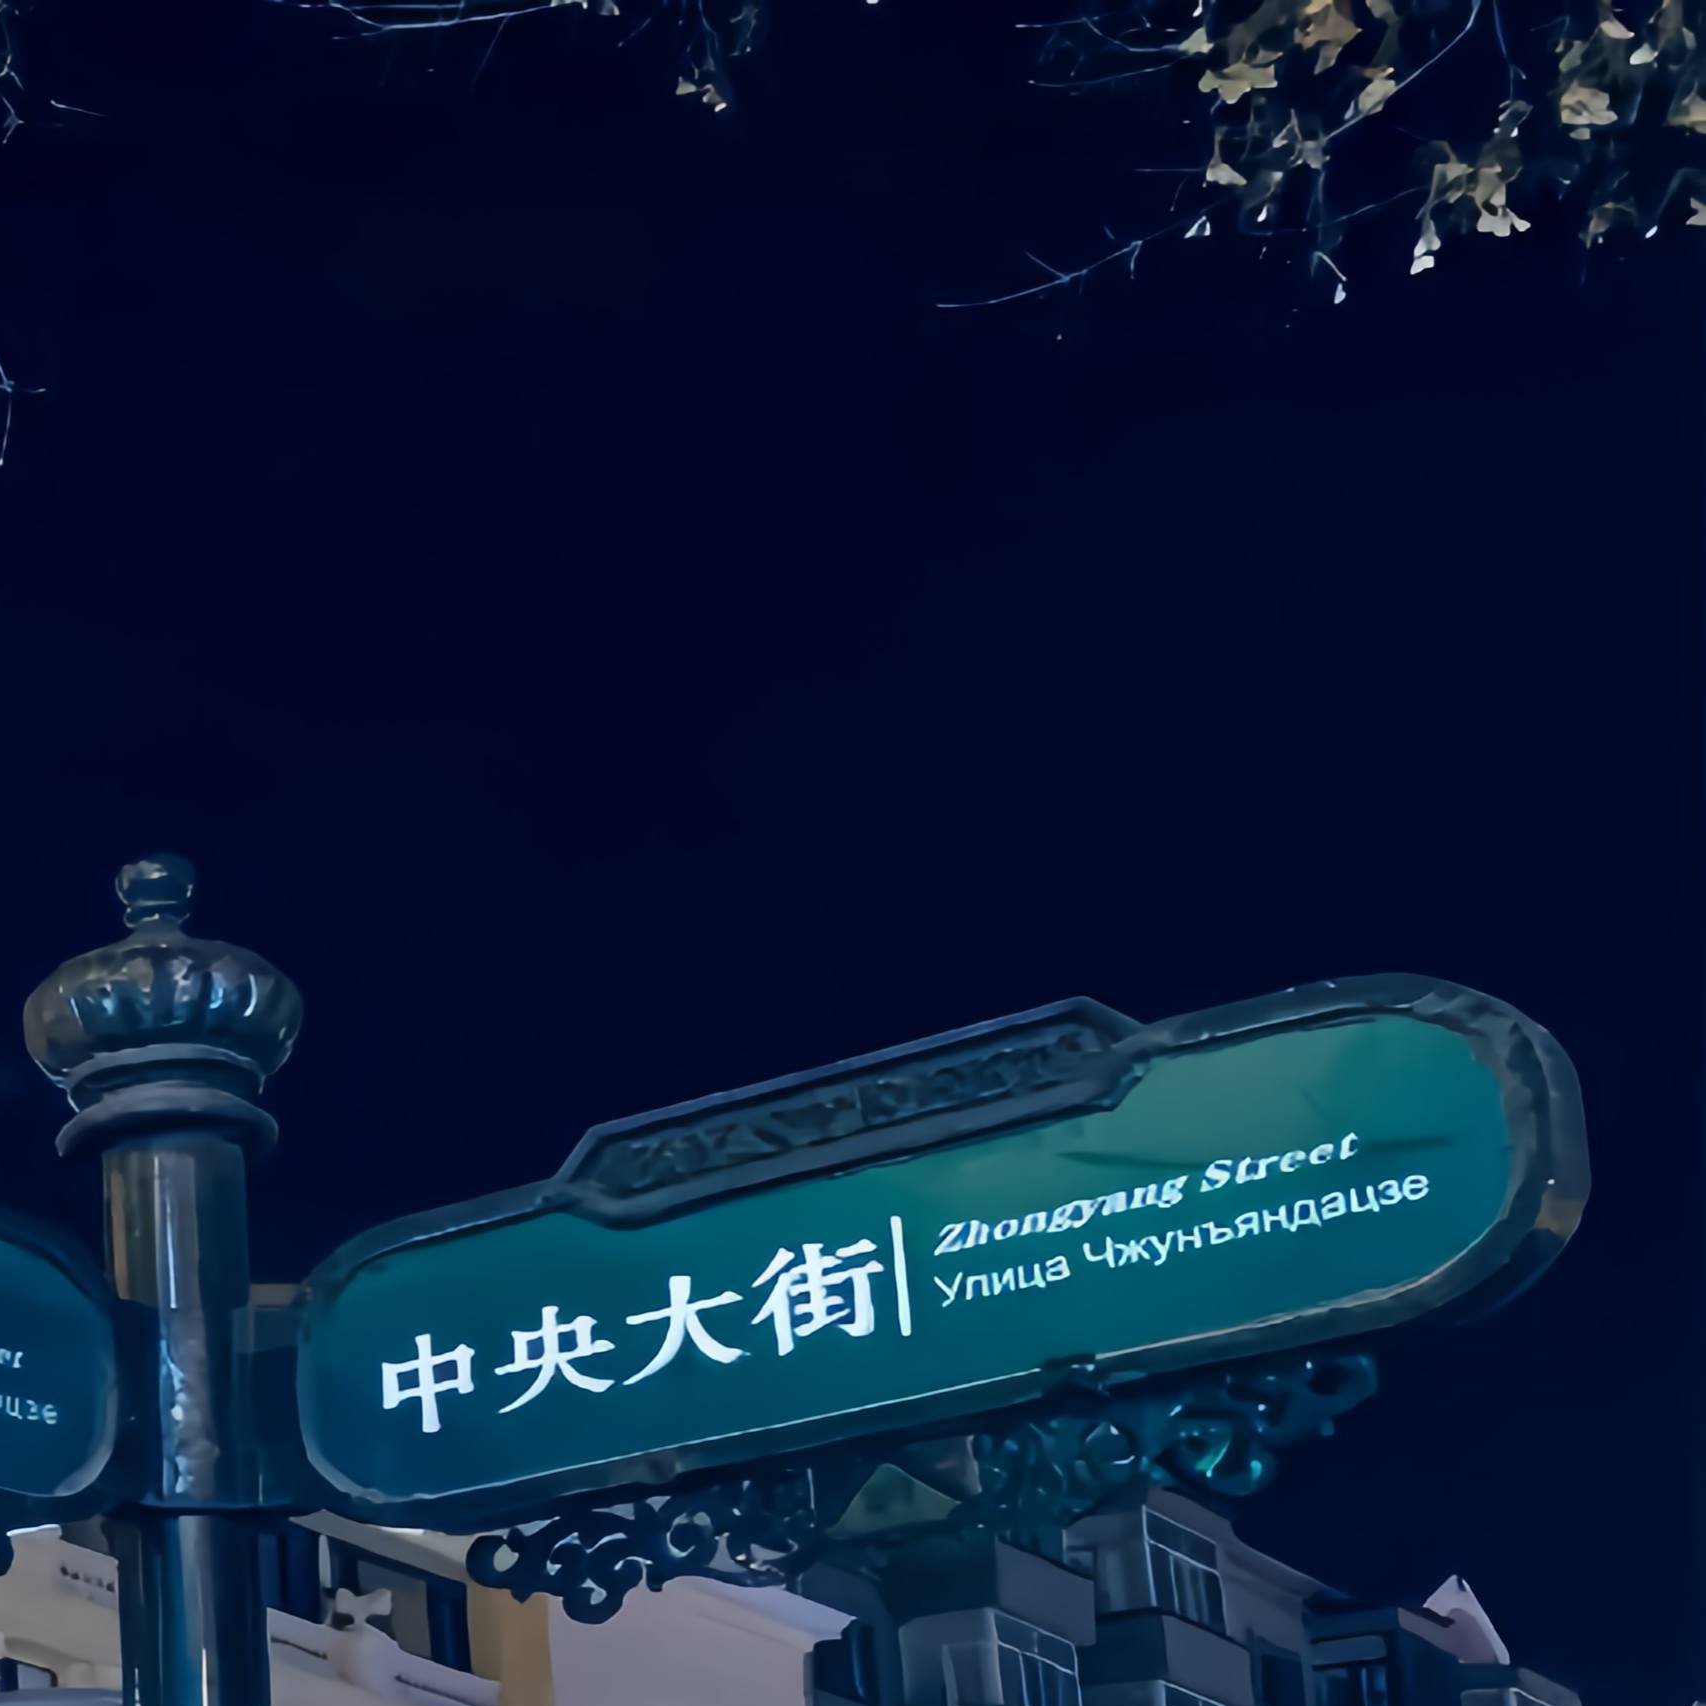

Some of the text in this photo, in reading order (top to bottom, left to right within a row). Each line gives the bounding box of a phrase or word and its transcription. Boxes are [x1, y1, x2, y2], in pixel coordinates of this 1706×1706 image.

[933, 1132, 1358, 1256] Zhongyang Street
[933, 1173, 1430, 1307] Улица Чжунъяндацзе
[382, 1238, 885, 1433] 中央大街
